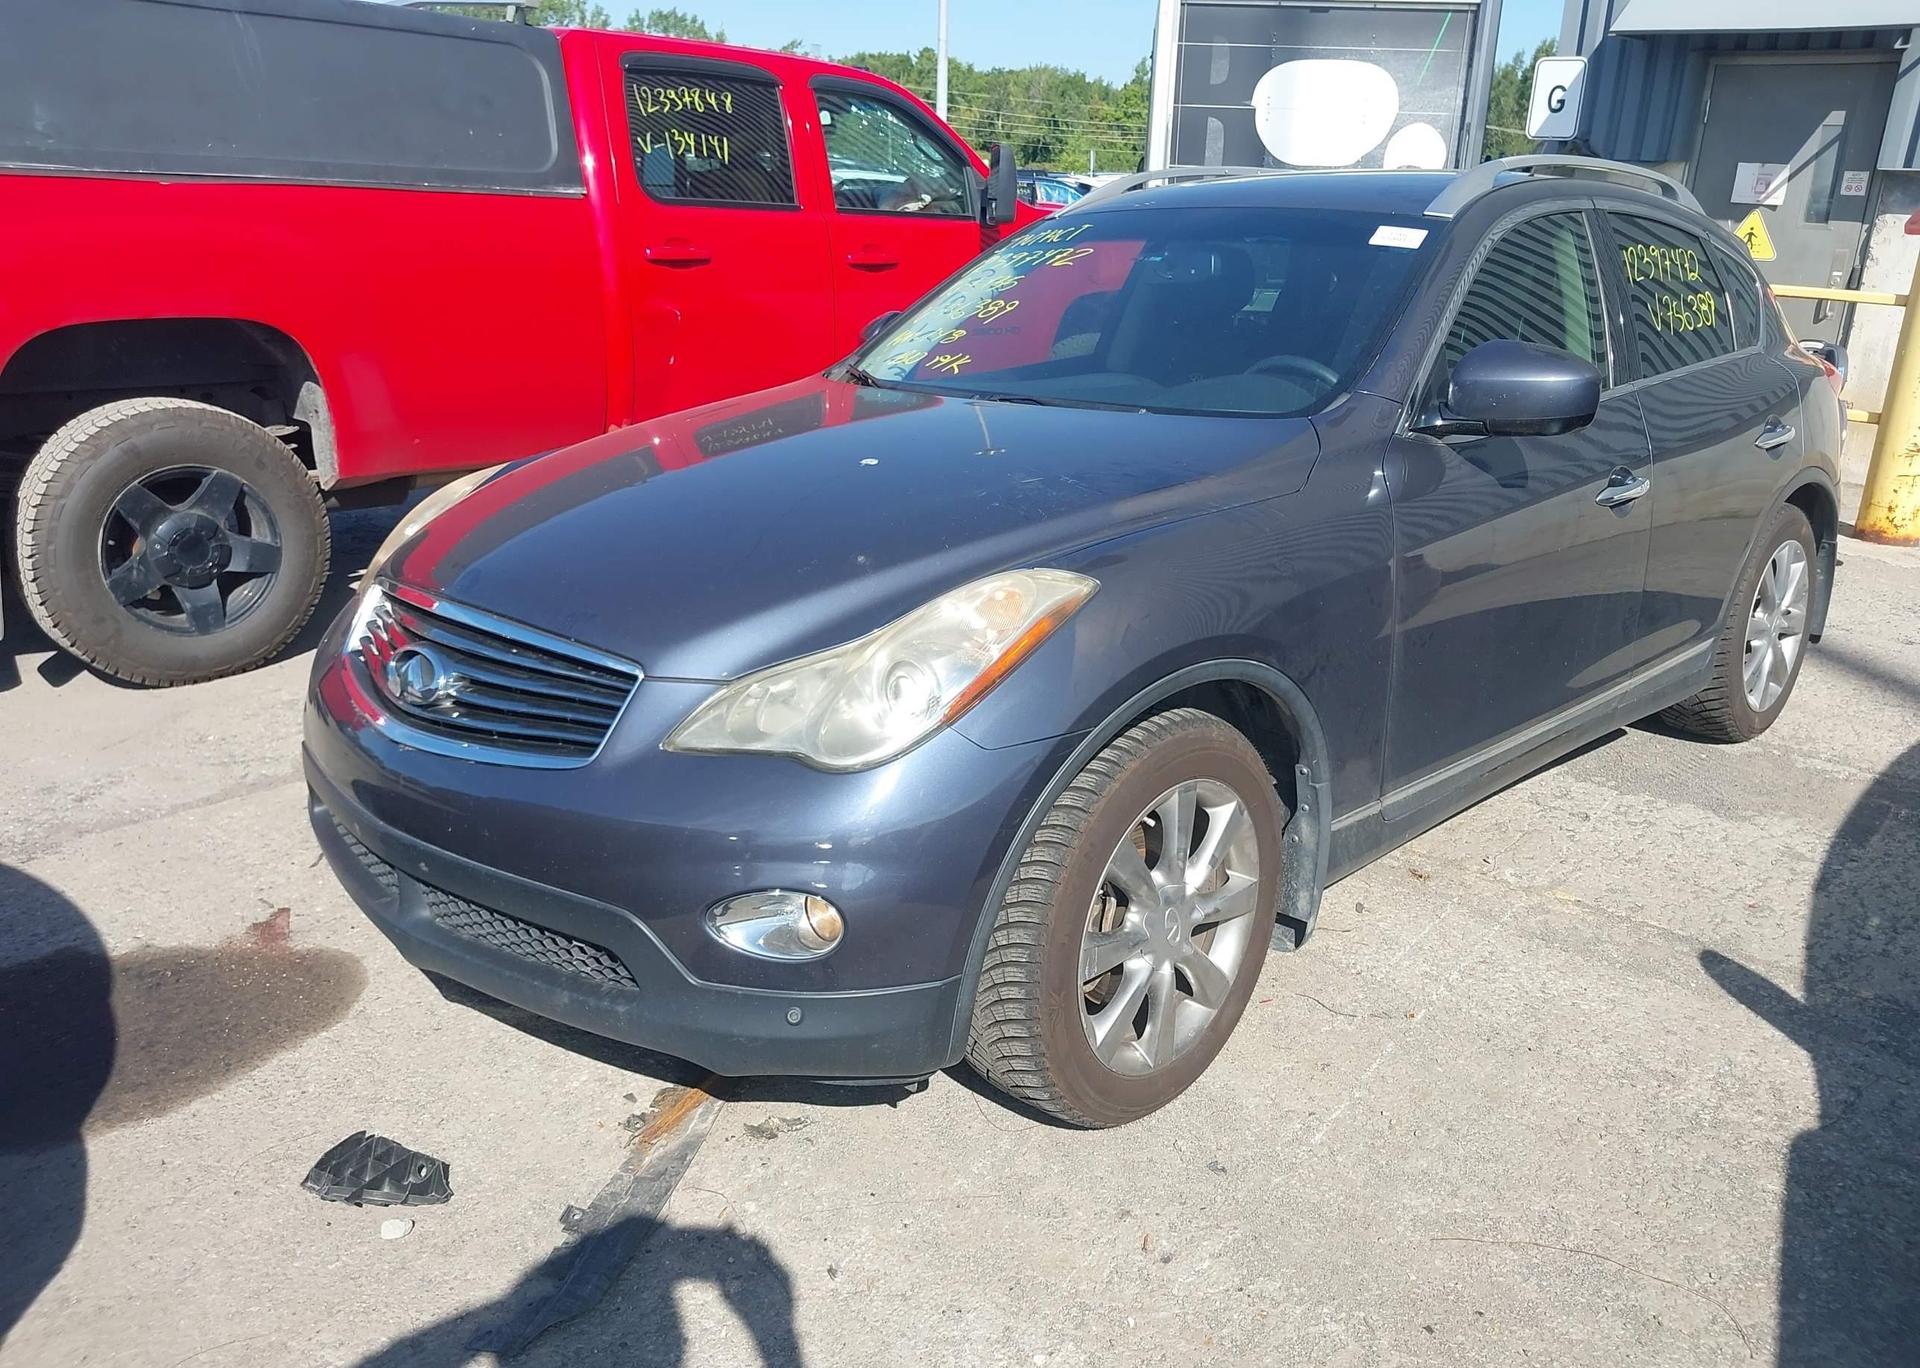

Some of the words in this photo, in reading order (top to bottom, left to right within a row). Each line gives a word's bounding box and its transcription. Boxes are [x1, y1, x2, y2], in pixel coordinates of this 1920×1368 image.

[632, 83, 733, 117] 12397848
[1548, 85, 1567, 114] G
[1622, 243, 1703, 288] 12397472
